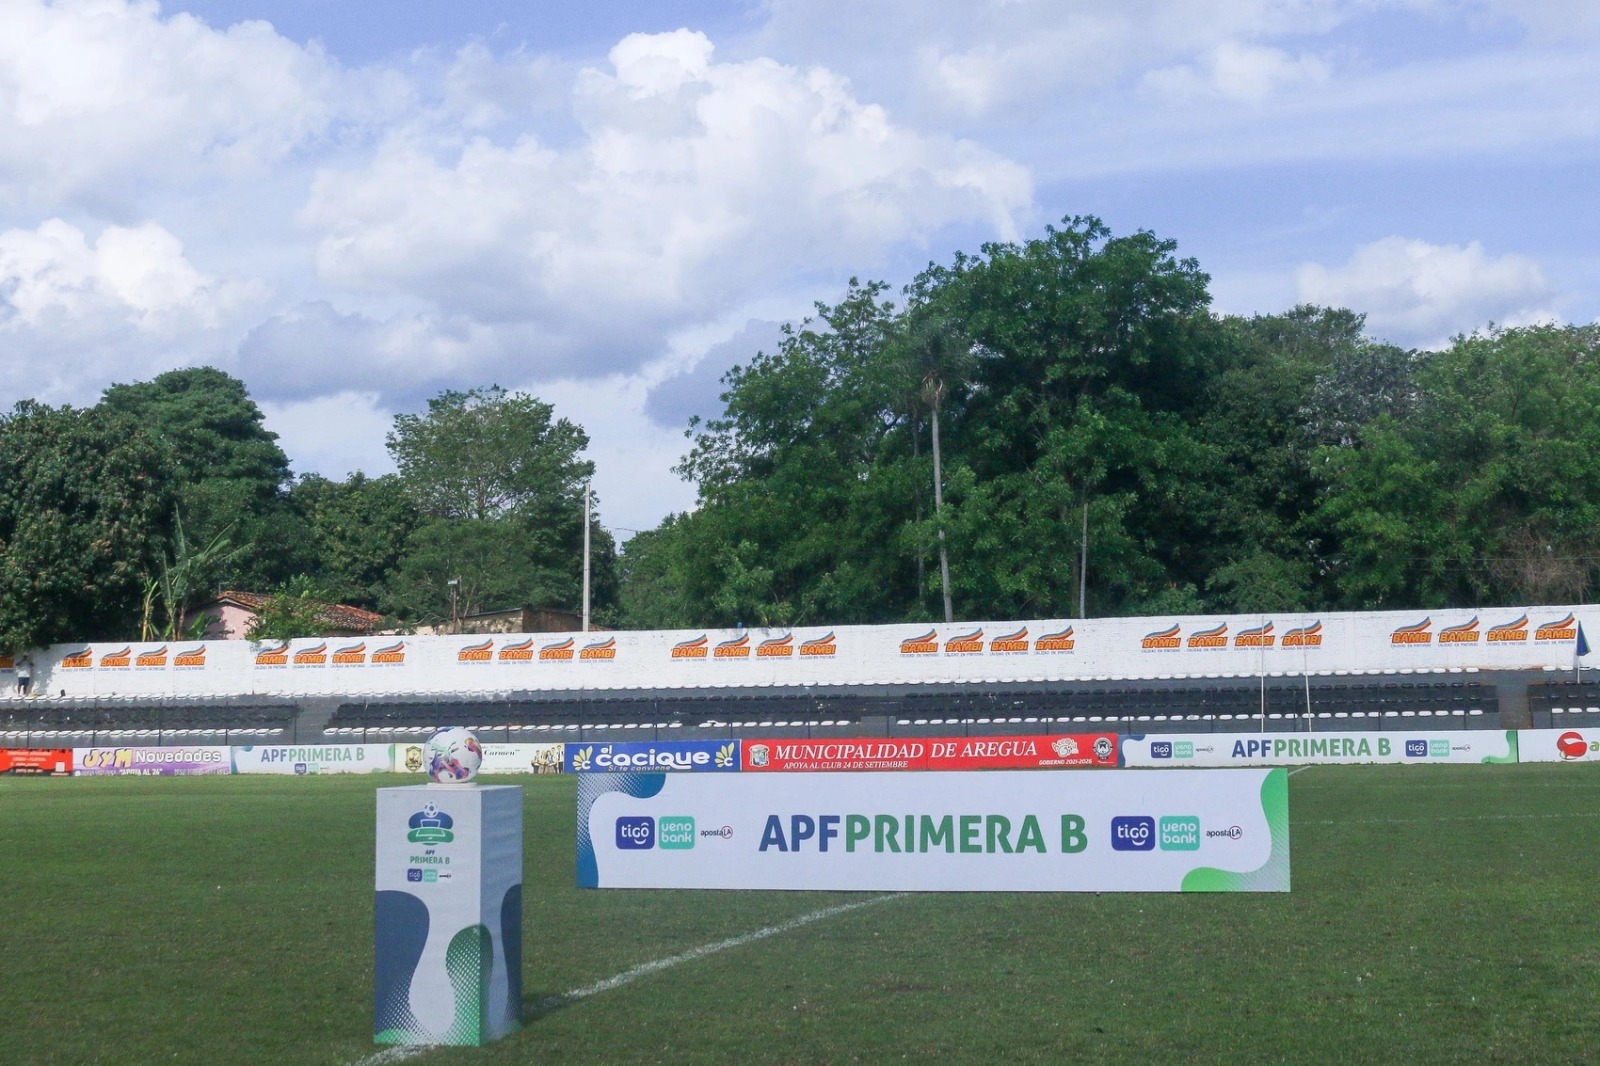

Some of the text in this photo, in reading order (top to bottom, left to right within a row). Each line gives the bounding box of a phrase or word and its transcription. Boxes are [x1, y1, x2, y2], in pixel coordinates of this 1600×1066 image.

[1392, 632, 1432, 643] BAMBI
[1439, 631, 1480, 642] BAMBI
[1487, 630, 1528, 641] BAMBI
[1535, 629, 1576, 640] BAMBI
[1035, 640, 1074, 650] BAMBI
[1142, 637, 1181, 648] BAMBI
[1188, 637, 1228, 647] BAMBI
[1235, 636, 1275, 646] BAMBI
[1282, 635, 1322, 646] BAMBI
[757, 646, 793, 656] BAMBI
[800, 645, 836, 655] BAMBI
[901, 643, 938, 653] BAMBI
[945, 642, 983, 652] BAMBI
[991, 641, 1028, 651] BAMBI
[458, 651, 493, 660] BAMBI
[499, 650, 533, 660] BAMBI
[539, 650, 574, 659] BAMBI
[580, 649, 616, 659] BAMBI
[671, 647, 708, 657] BAMBI
[714, 647, 750, 657] BAMBI
[62, 657, 92, 667] BAMBI
[100, 657, 130, 667] BAMBI
[136, 656, 167, 666] BAMBI
[174, 656, 205, 666] BAMBI
[256, 655, 288, 664] BAMBI
[293, 654, 326, 664] BAMBI
[332, 654, 365, 663] BAMBI
[371, 653, 405, 663] BAMBI
[601, 745, 612, 754] el
[775, 741, 1038, 760] MUNICIPALIDAD DE AREGUA
[1378, 737, 1391, 756] B
[135, 750, 222, 763] Novedades
[356, 747, 365, 761] B
[853, 761, 863, 769] DE
[661, 823, 692, 831] ueno
[1163, 823, 1196, 832] ueno
[661, 832, 692, 843] bank
[1061, 814, 1088, 853] B
[1163, 833, 1196, 843] bank
[410, 856, 443, 864] PRIMERA
